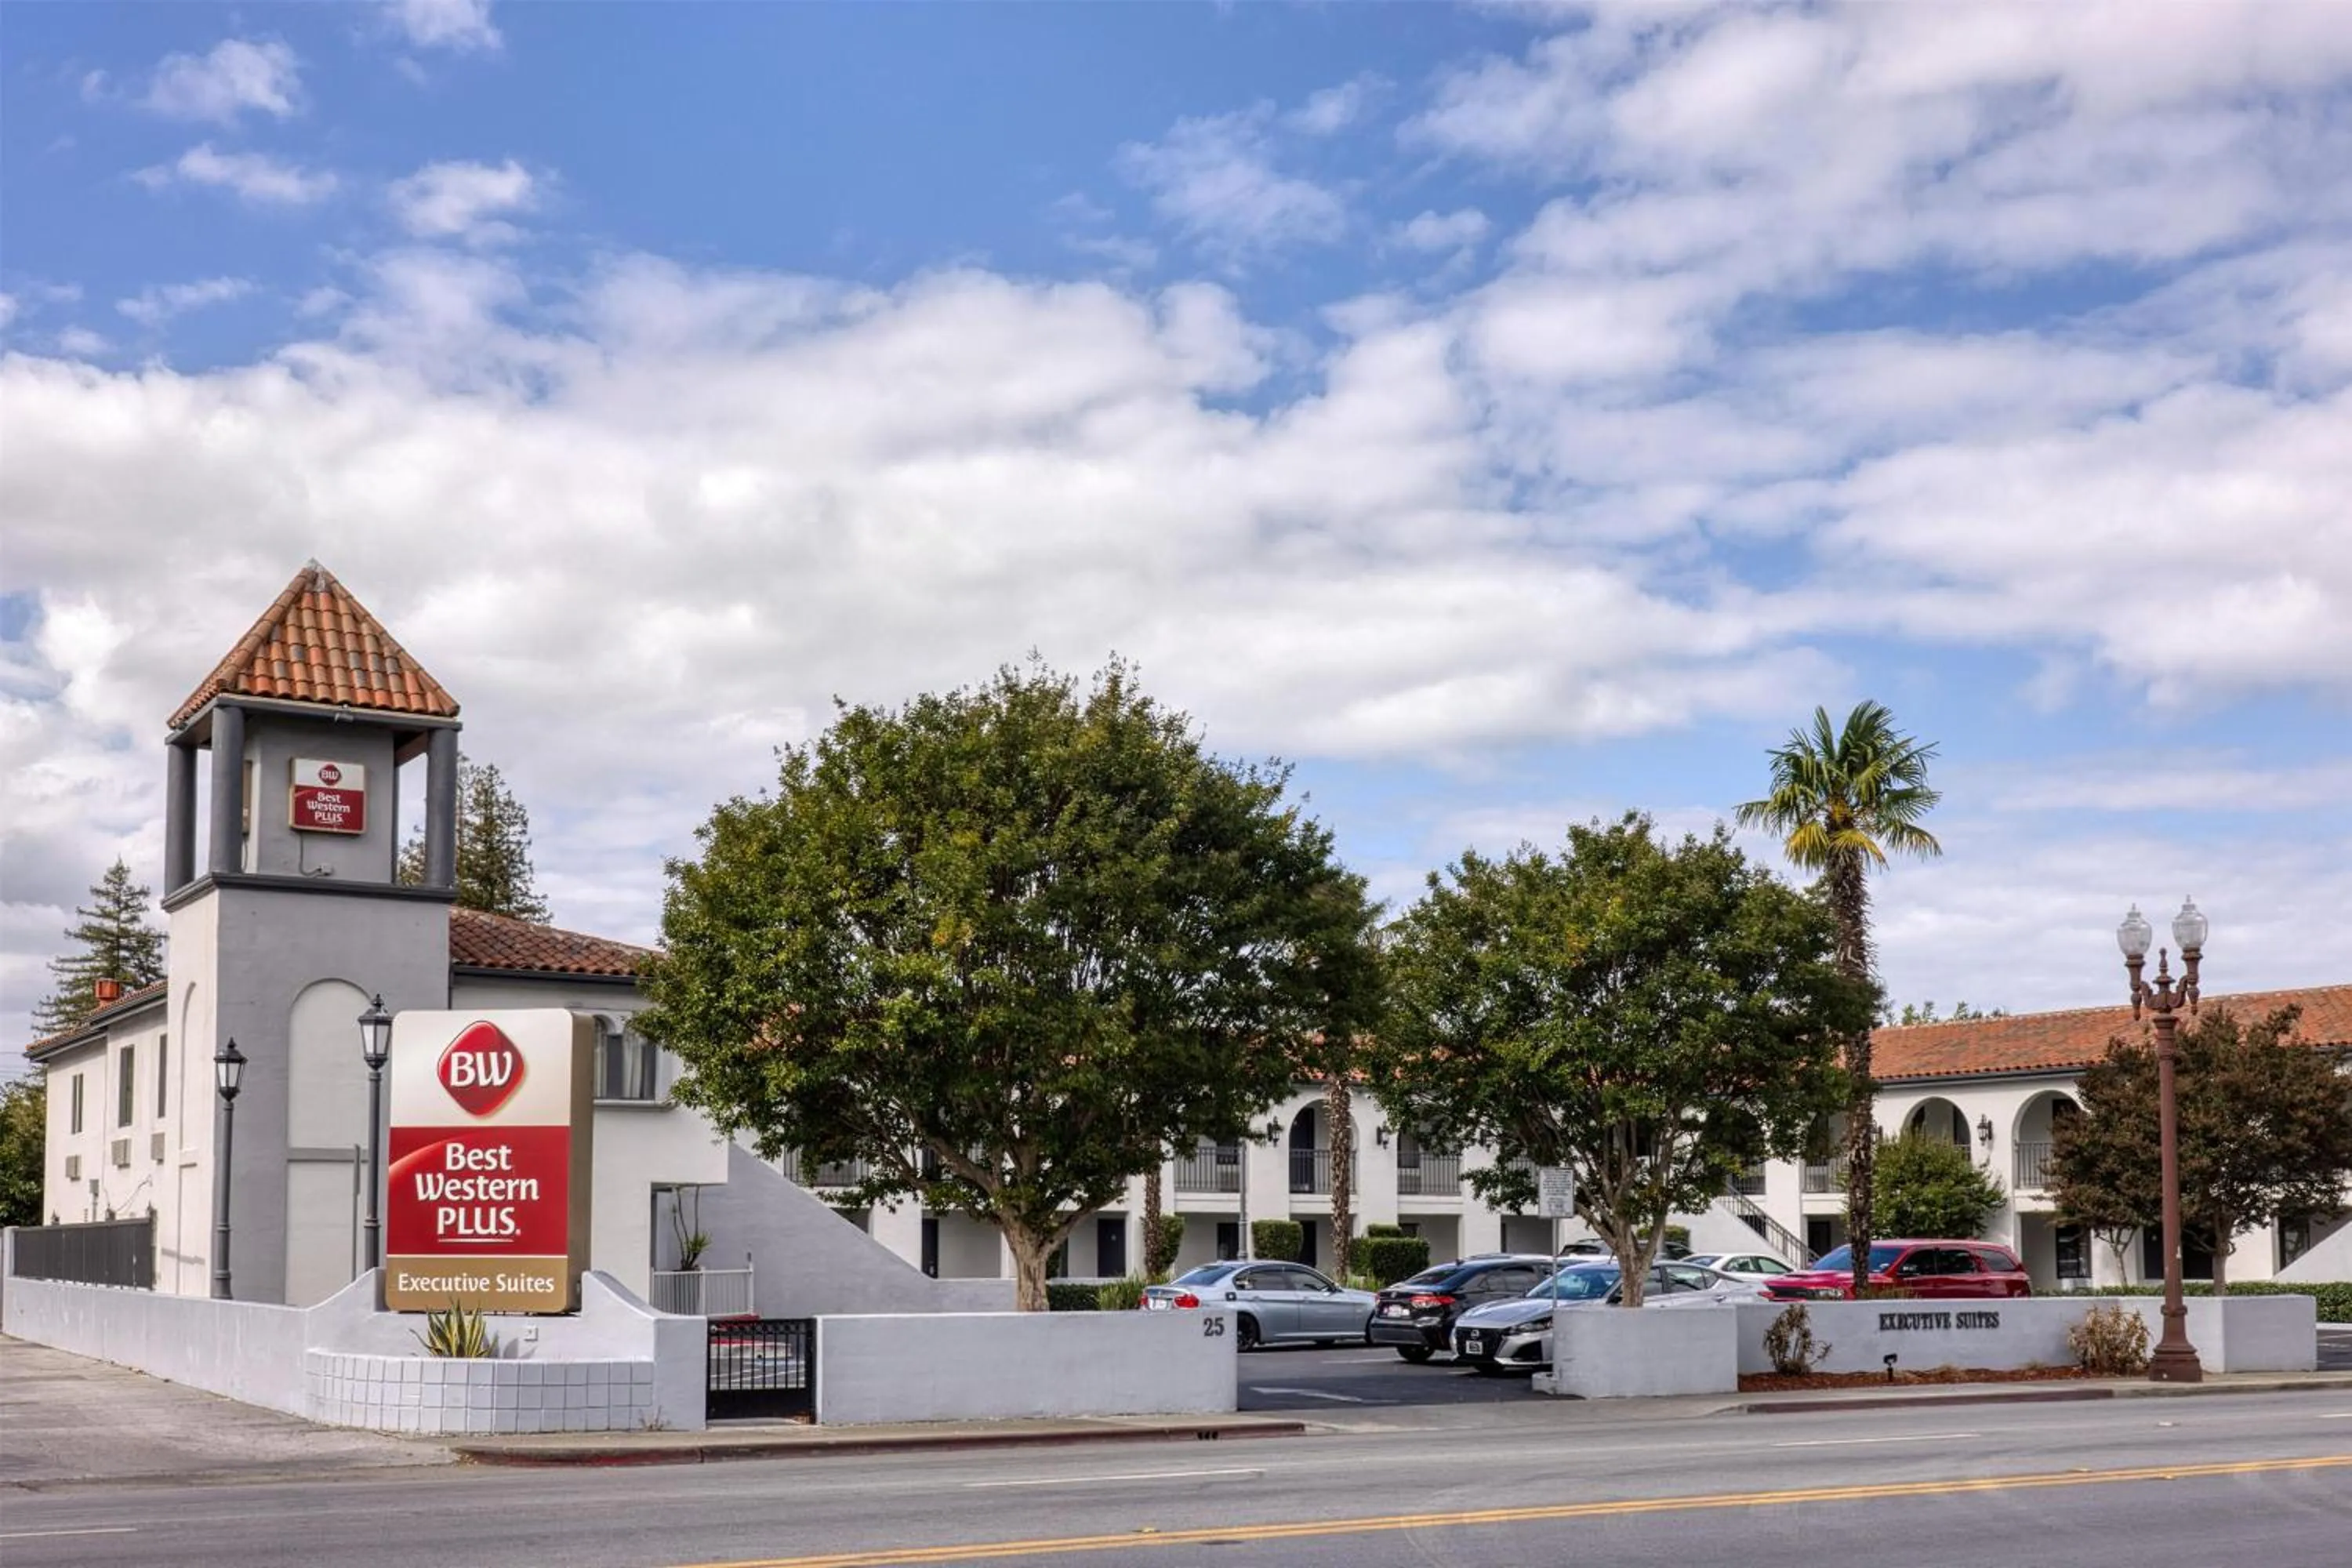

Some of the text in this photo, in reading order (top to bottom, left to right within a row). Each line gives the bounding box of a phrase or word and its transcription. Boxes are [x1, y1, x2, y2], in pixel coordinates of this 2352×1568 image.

[320, 770, 339, 780] BW
[307, 800, 350, 813] Western
[317, 791, 342, 804] Best
[449, 1051, 514, 1088] BW
[445, 1142, 512, 1171] Best
[415, 1173, 540, 1201] Western
[397, 1272, 555, 1293] Executive Suites
[1203, 1316, 1225, 1337] 25
[1879, 1310, 1999, 1330] EXECUTIVE SUITES
